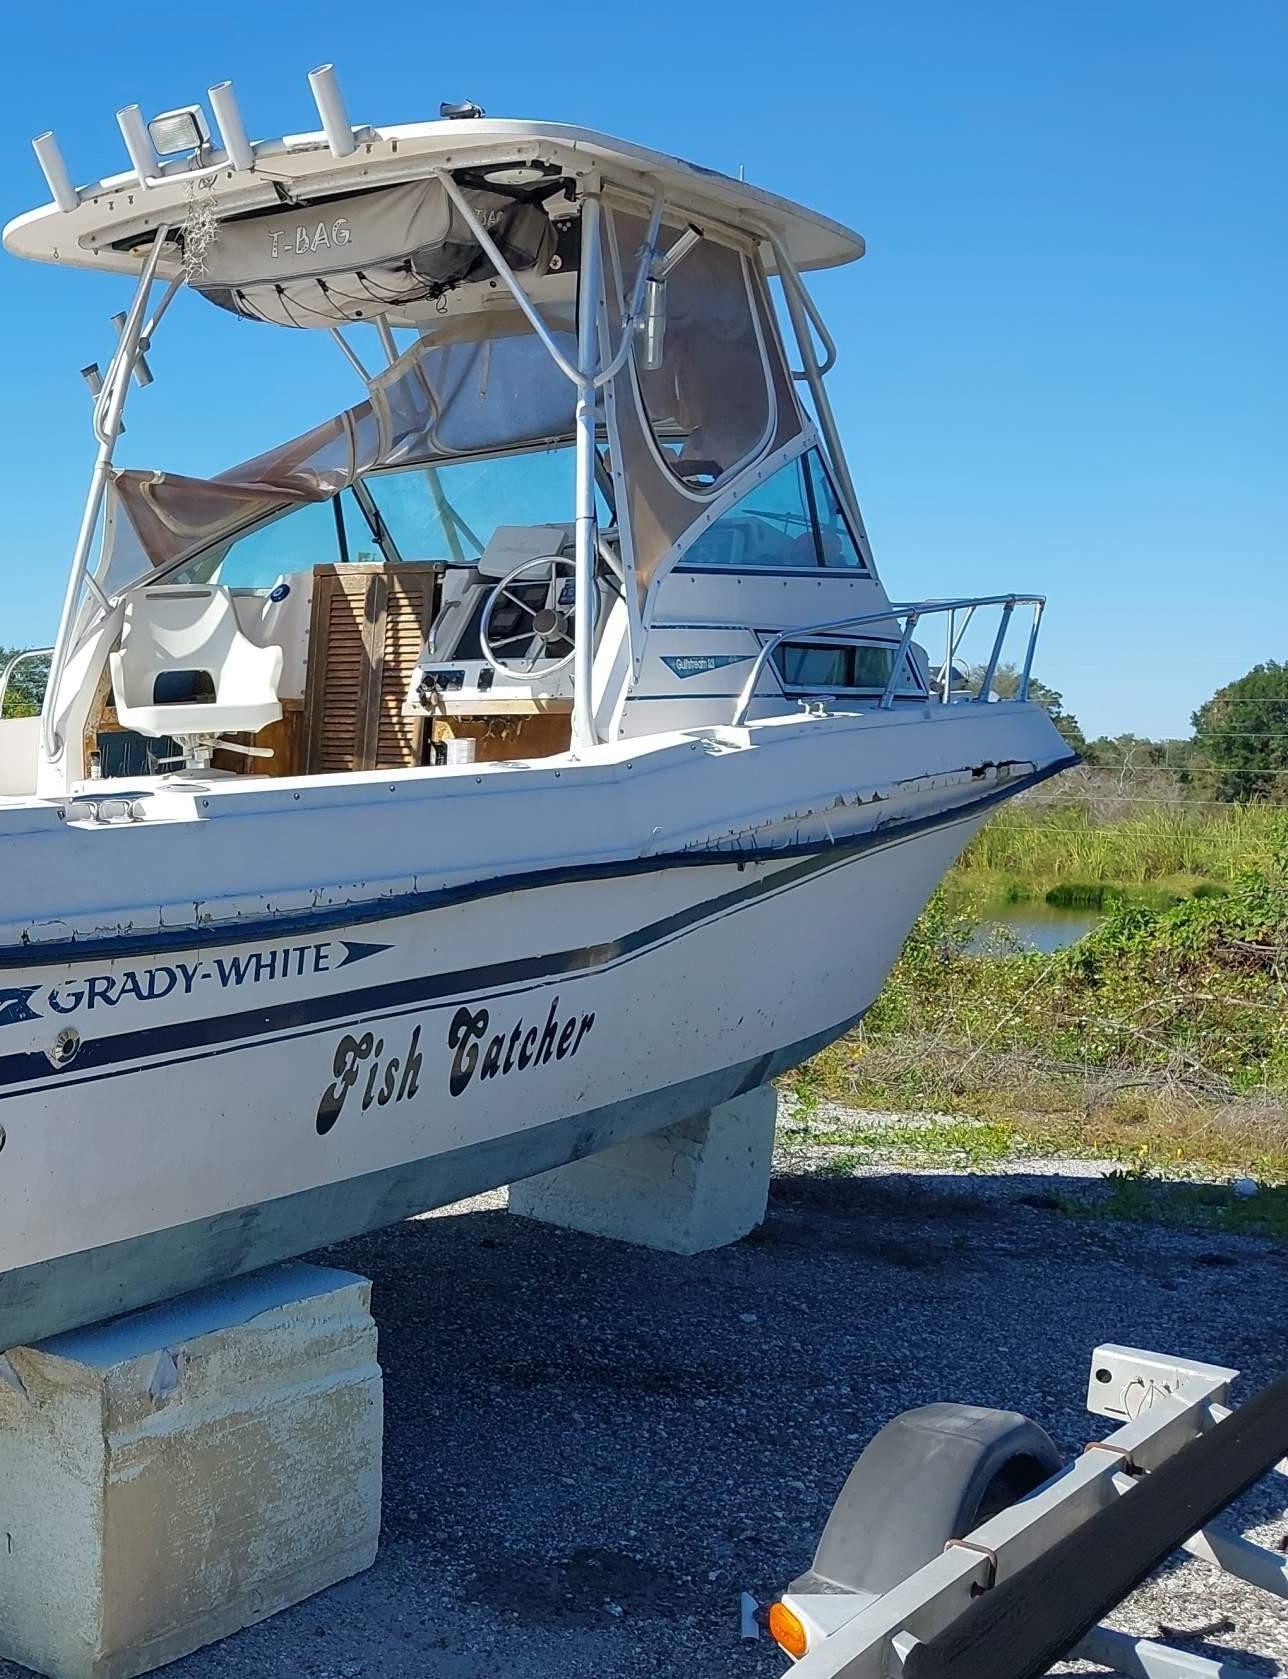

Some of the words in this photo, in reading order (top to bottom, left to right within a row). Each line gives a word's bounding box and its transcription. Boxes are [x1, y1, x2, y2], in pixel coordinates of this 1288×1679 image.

[268, 218, 350, 257] T-BAG
[47, 942, 331, 1014] GRADY-WHITE
[316, 1024, 422, 1136] Fish
[449, 995, 596, 1097] Catcher
